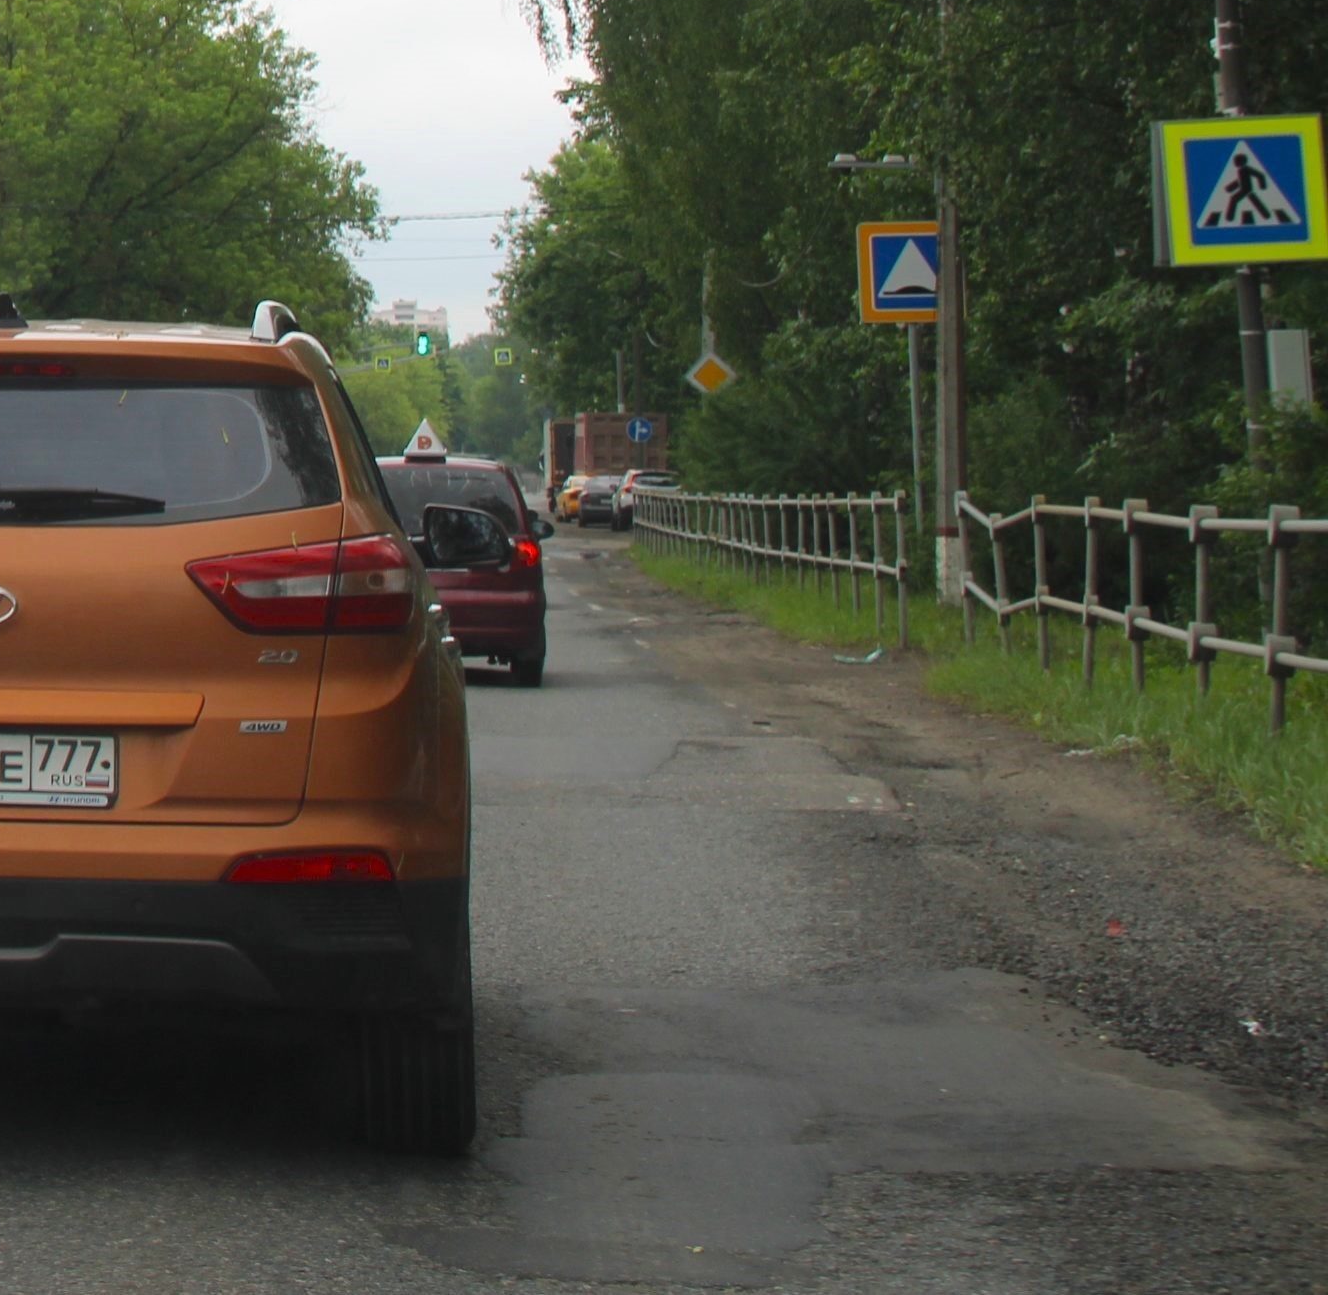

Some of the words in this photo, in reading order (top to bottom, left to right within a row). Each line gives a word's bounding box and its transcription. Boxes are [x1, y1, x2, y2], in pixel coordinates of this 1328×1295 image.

[245, 722, 282, 732] 4WD
[34, 739, 101, 773] 777
[50, 773, 84, 787] RUS
